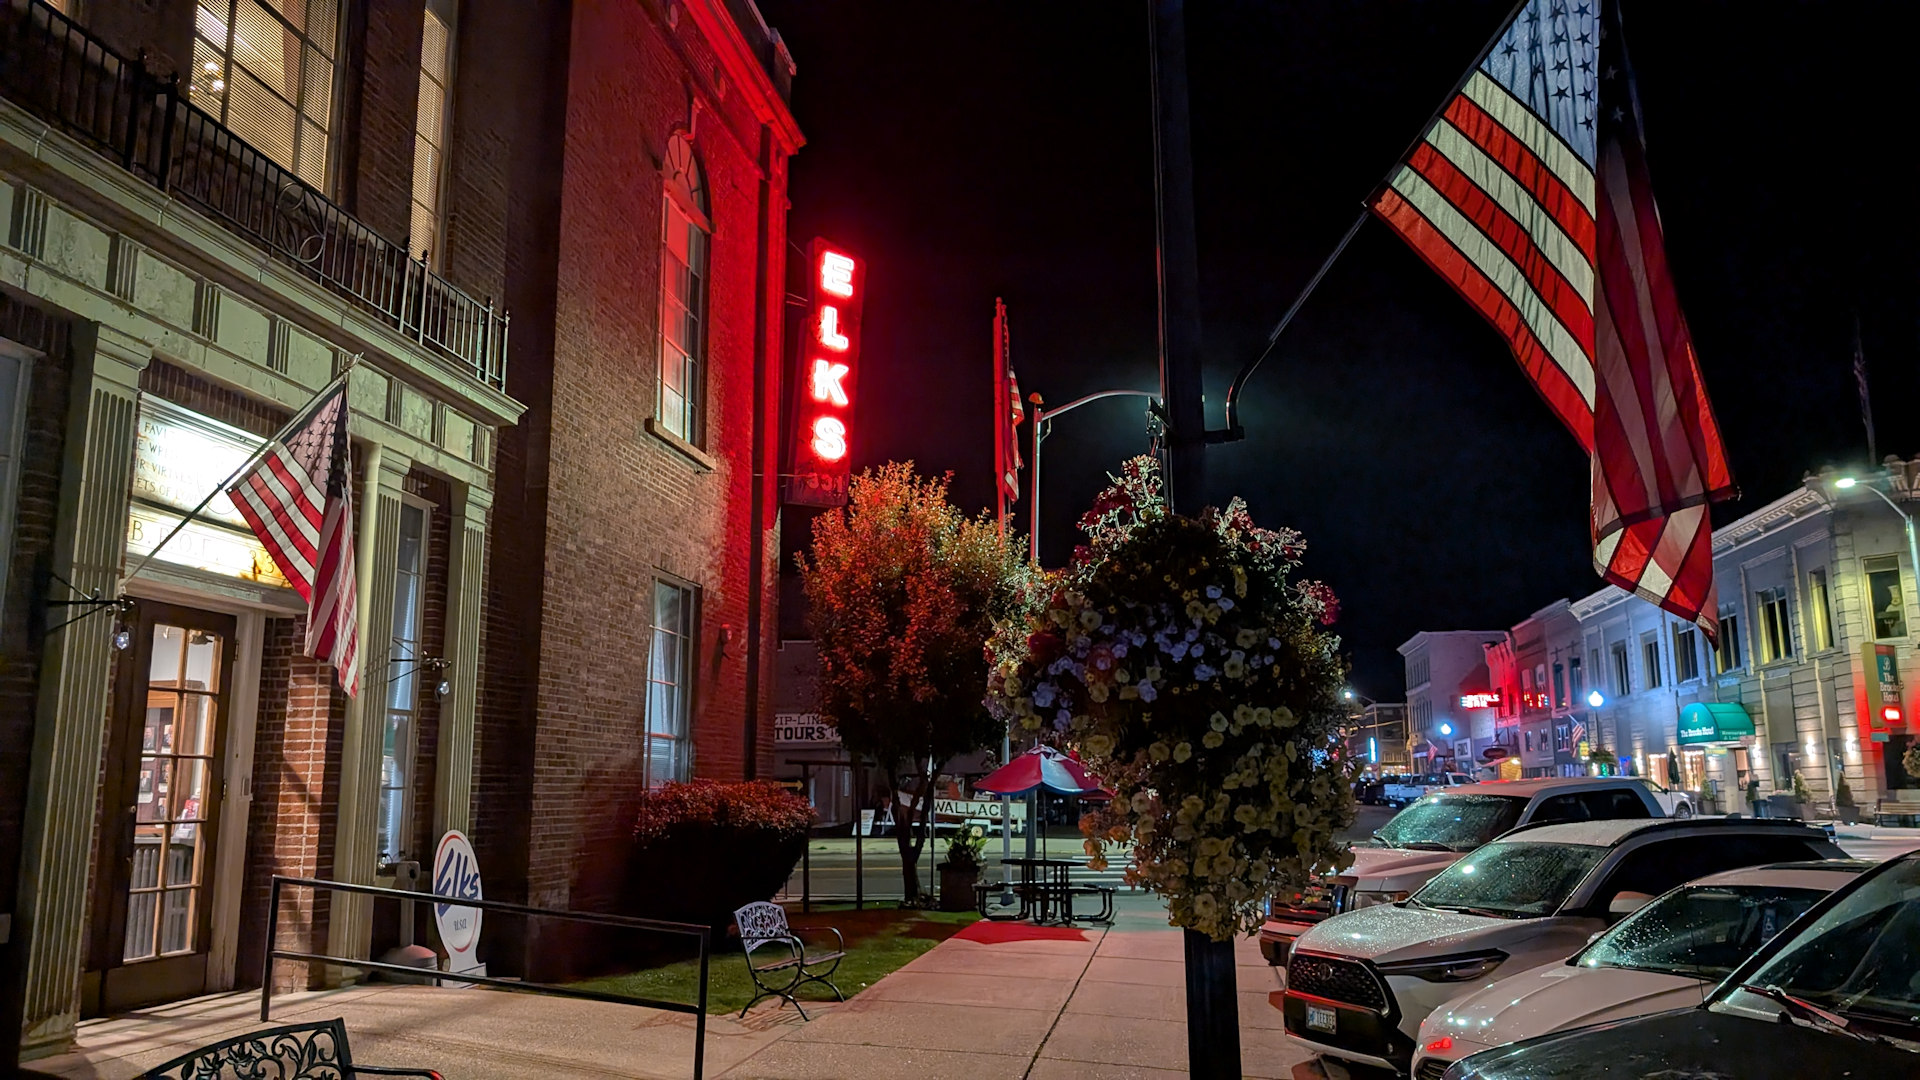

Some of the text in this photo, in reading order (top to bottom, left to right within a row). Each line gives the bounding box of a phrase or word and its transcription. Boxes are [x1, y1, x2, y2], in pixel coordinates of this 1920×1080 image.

[813, 250, 855, 460] ELKS
[774, 714, 820, 726] ZIP-LIN
[774, 726, 825, 741] TOURS
[435, 847, 479, 918] Elks
